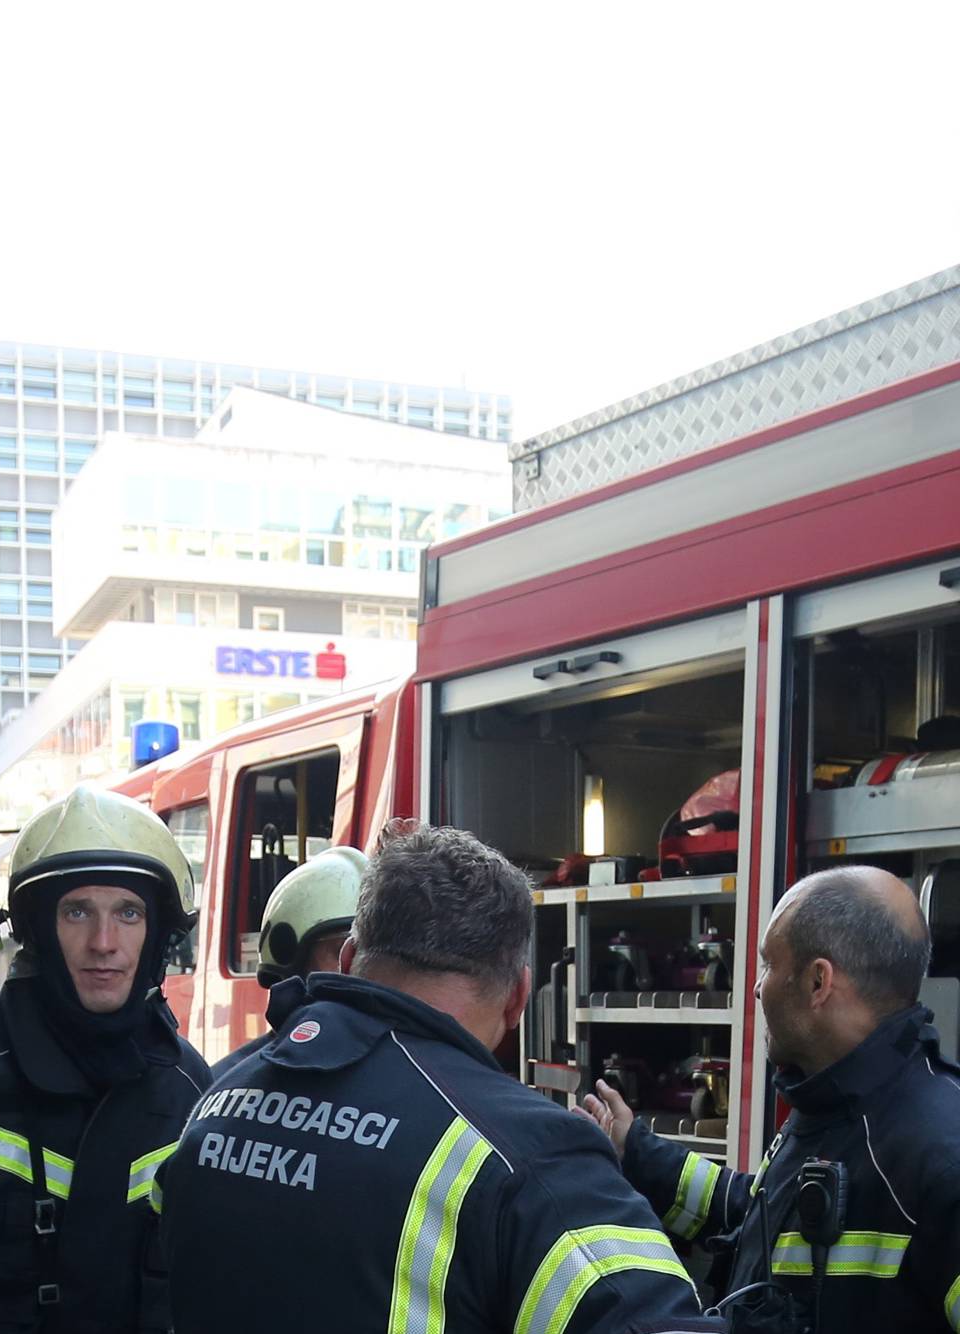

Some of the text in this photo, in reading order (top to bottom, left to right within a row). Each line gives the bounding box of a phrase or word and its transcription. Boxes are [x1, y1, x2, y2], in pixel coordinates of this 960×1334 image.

[216, 646, 311, 678] ERSTE
[196, 1088, 400, 1149] VATROGASCI
[198, 1132, 318, 1191] RIJEKA
